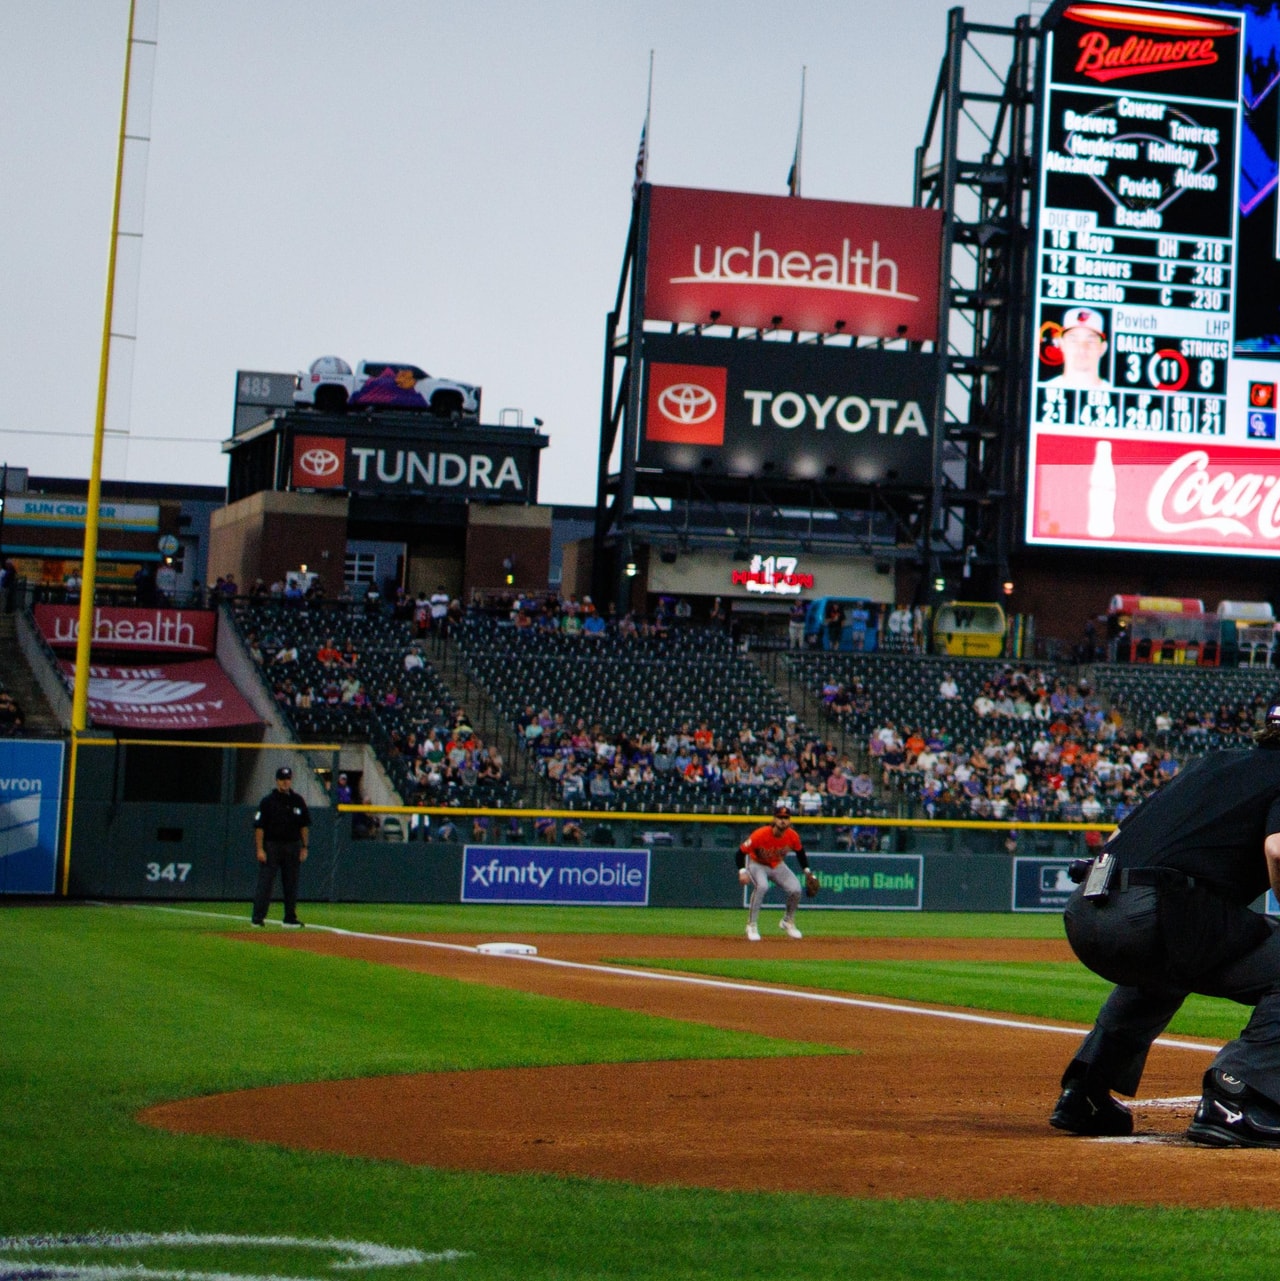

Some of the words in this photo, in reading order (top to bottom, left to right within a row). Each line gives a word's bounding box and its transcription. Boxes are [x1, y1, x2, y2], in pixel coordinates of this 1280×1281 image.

[1075, 31, 1218, 80] Baltimore
[1118, 97, 1167, 120] Cowser
[1064, 109, 1117, 134] Beavers
[1170, 120, 1219, 144] Taveras
[1071, 134, 1138, 160] Henderson
[1148, 142, 1198, 169] Holliday
[1046, 151, 1108, 176] Alexander
[1119, 175, 1161, 199] Povich
[1175, 168, 1217, 191] Alonso
[1049, 212, 1070, 227] DUE
[1074, 214, 1090, 228] UP
[1116, 206, 1162, 229] Basallo
[1051, 230, 1070, 249] 16
[1076, 231, 1114, 255] Mayo
[1158, 238, 1178, 258] DH
[694, 231, 899, 295] uchealth
[1050, 254, 1068, 274] 12
[1075, 256, 1132, 279] Beavers
[1158, 263, 1176, 282] LF
[1074, 280, 1125, 303] Basallo
[1160, 287, 1172, 306] C
[1117, 311, 1158, 330] Povich
[1206, 319, 1230, 337] LHP
[1116, 334, 1155, 353] BALLS
[1181, 339, 1228, 359] STRIKES
[1126, 354, 1141, 383] 3
[1160, 360, 1179, 382] 11
[1200, 359, 1215, 388] 8
[743, 389, 930, 437] TOYOTA
[1172, 411, 1194, 433] 10
[1201, 414, 1221, 435] 21
[351, 447, 524, 491] TUNDRA
[24, 502, 54, 514] SUN
[56, 504, 117, 518] CRUER
[55, 609, 195, 647] uhealth
[146, 862, 193, 882] 347
[471, 859, 553, 888] xfinity
[558, 861, 643, 887] mobile
[872, 872, 915, 890] Bank
